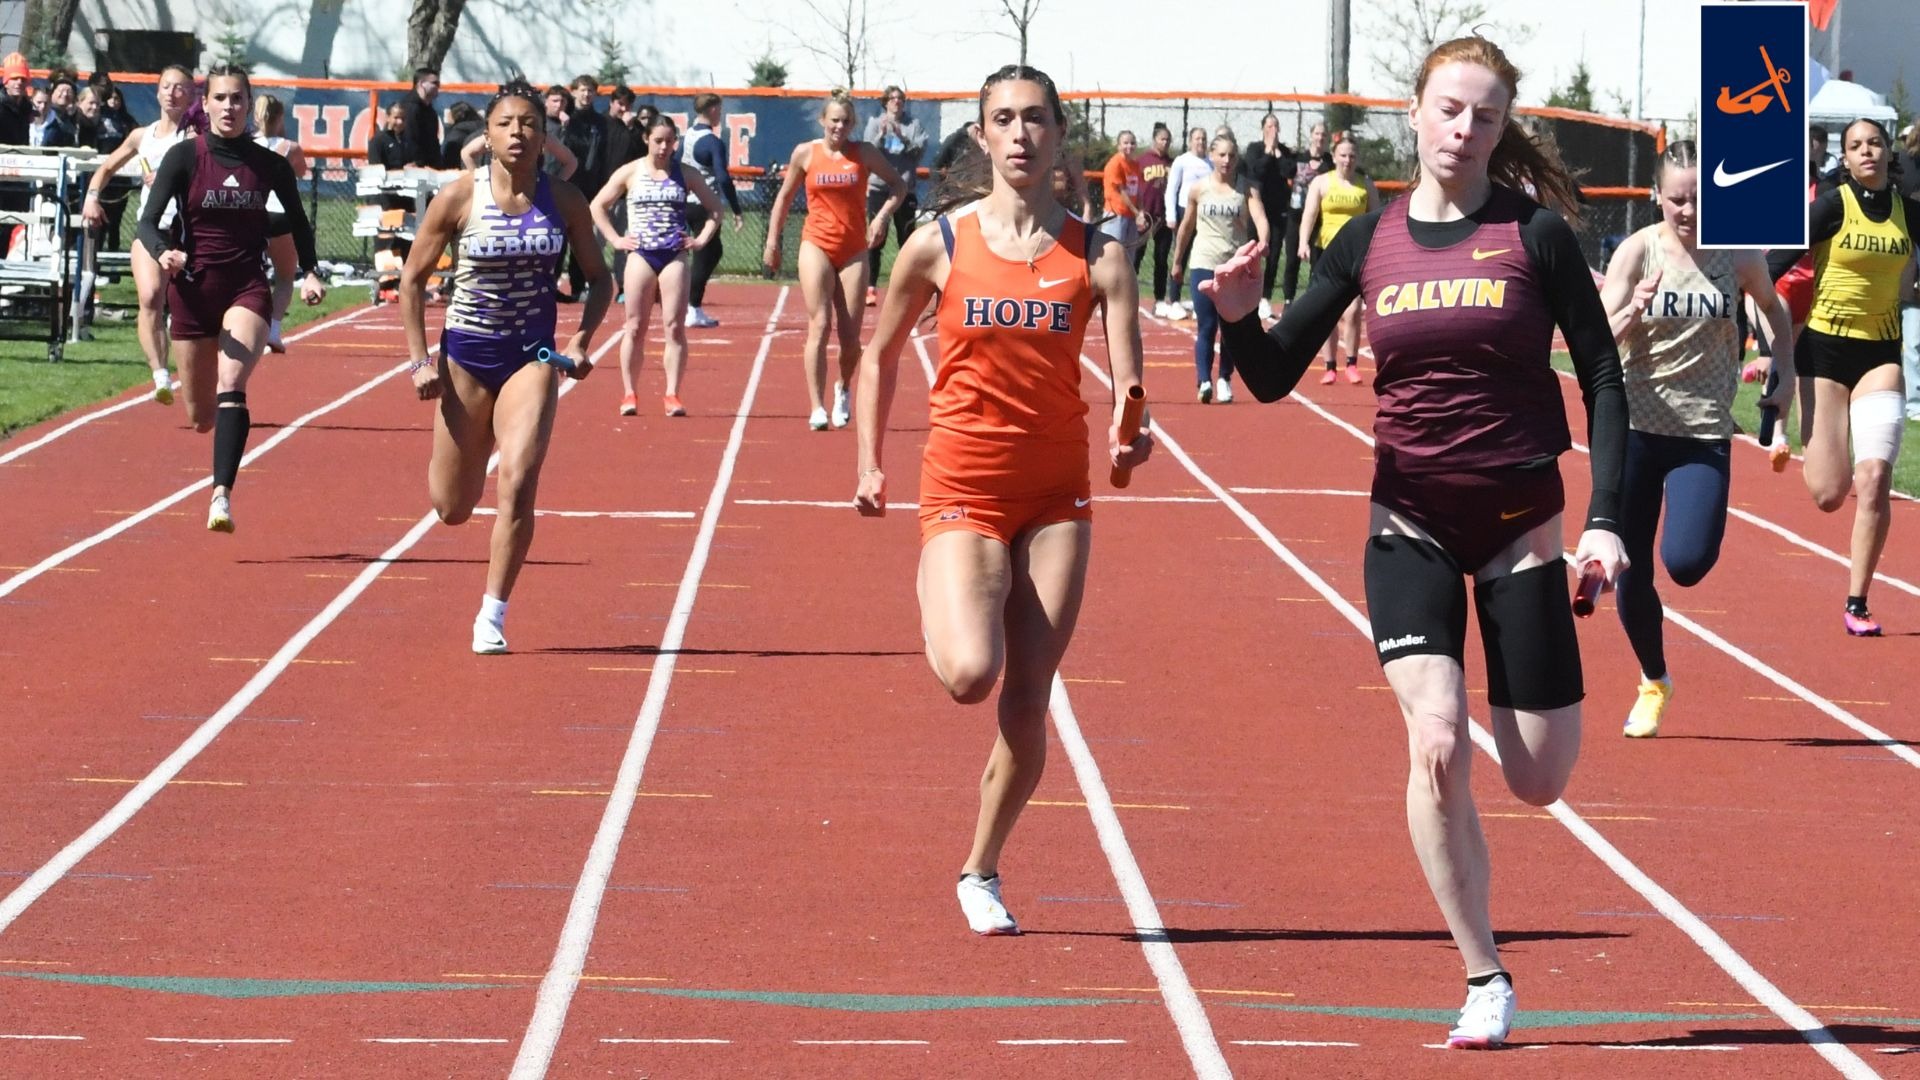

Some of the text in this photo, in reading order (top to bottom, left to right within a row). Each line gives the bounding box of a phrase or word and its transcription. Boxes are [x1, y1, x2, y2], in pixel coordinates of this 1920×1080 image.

[816, 173, 858, 186] HOPE
[202, 189, 264, 209] ALMA
[468, 234, 564, 256] ALBION
[1839, 232, 1910, 256] ADRIAN
[1376, 278, 1508, 317] CALVIN
[963, 297, 1073, 334] HOPE
